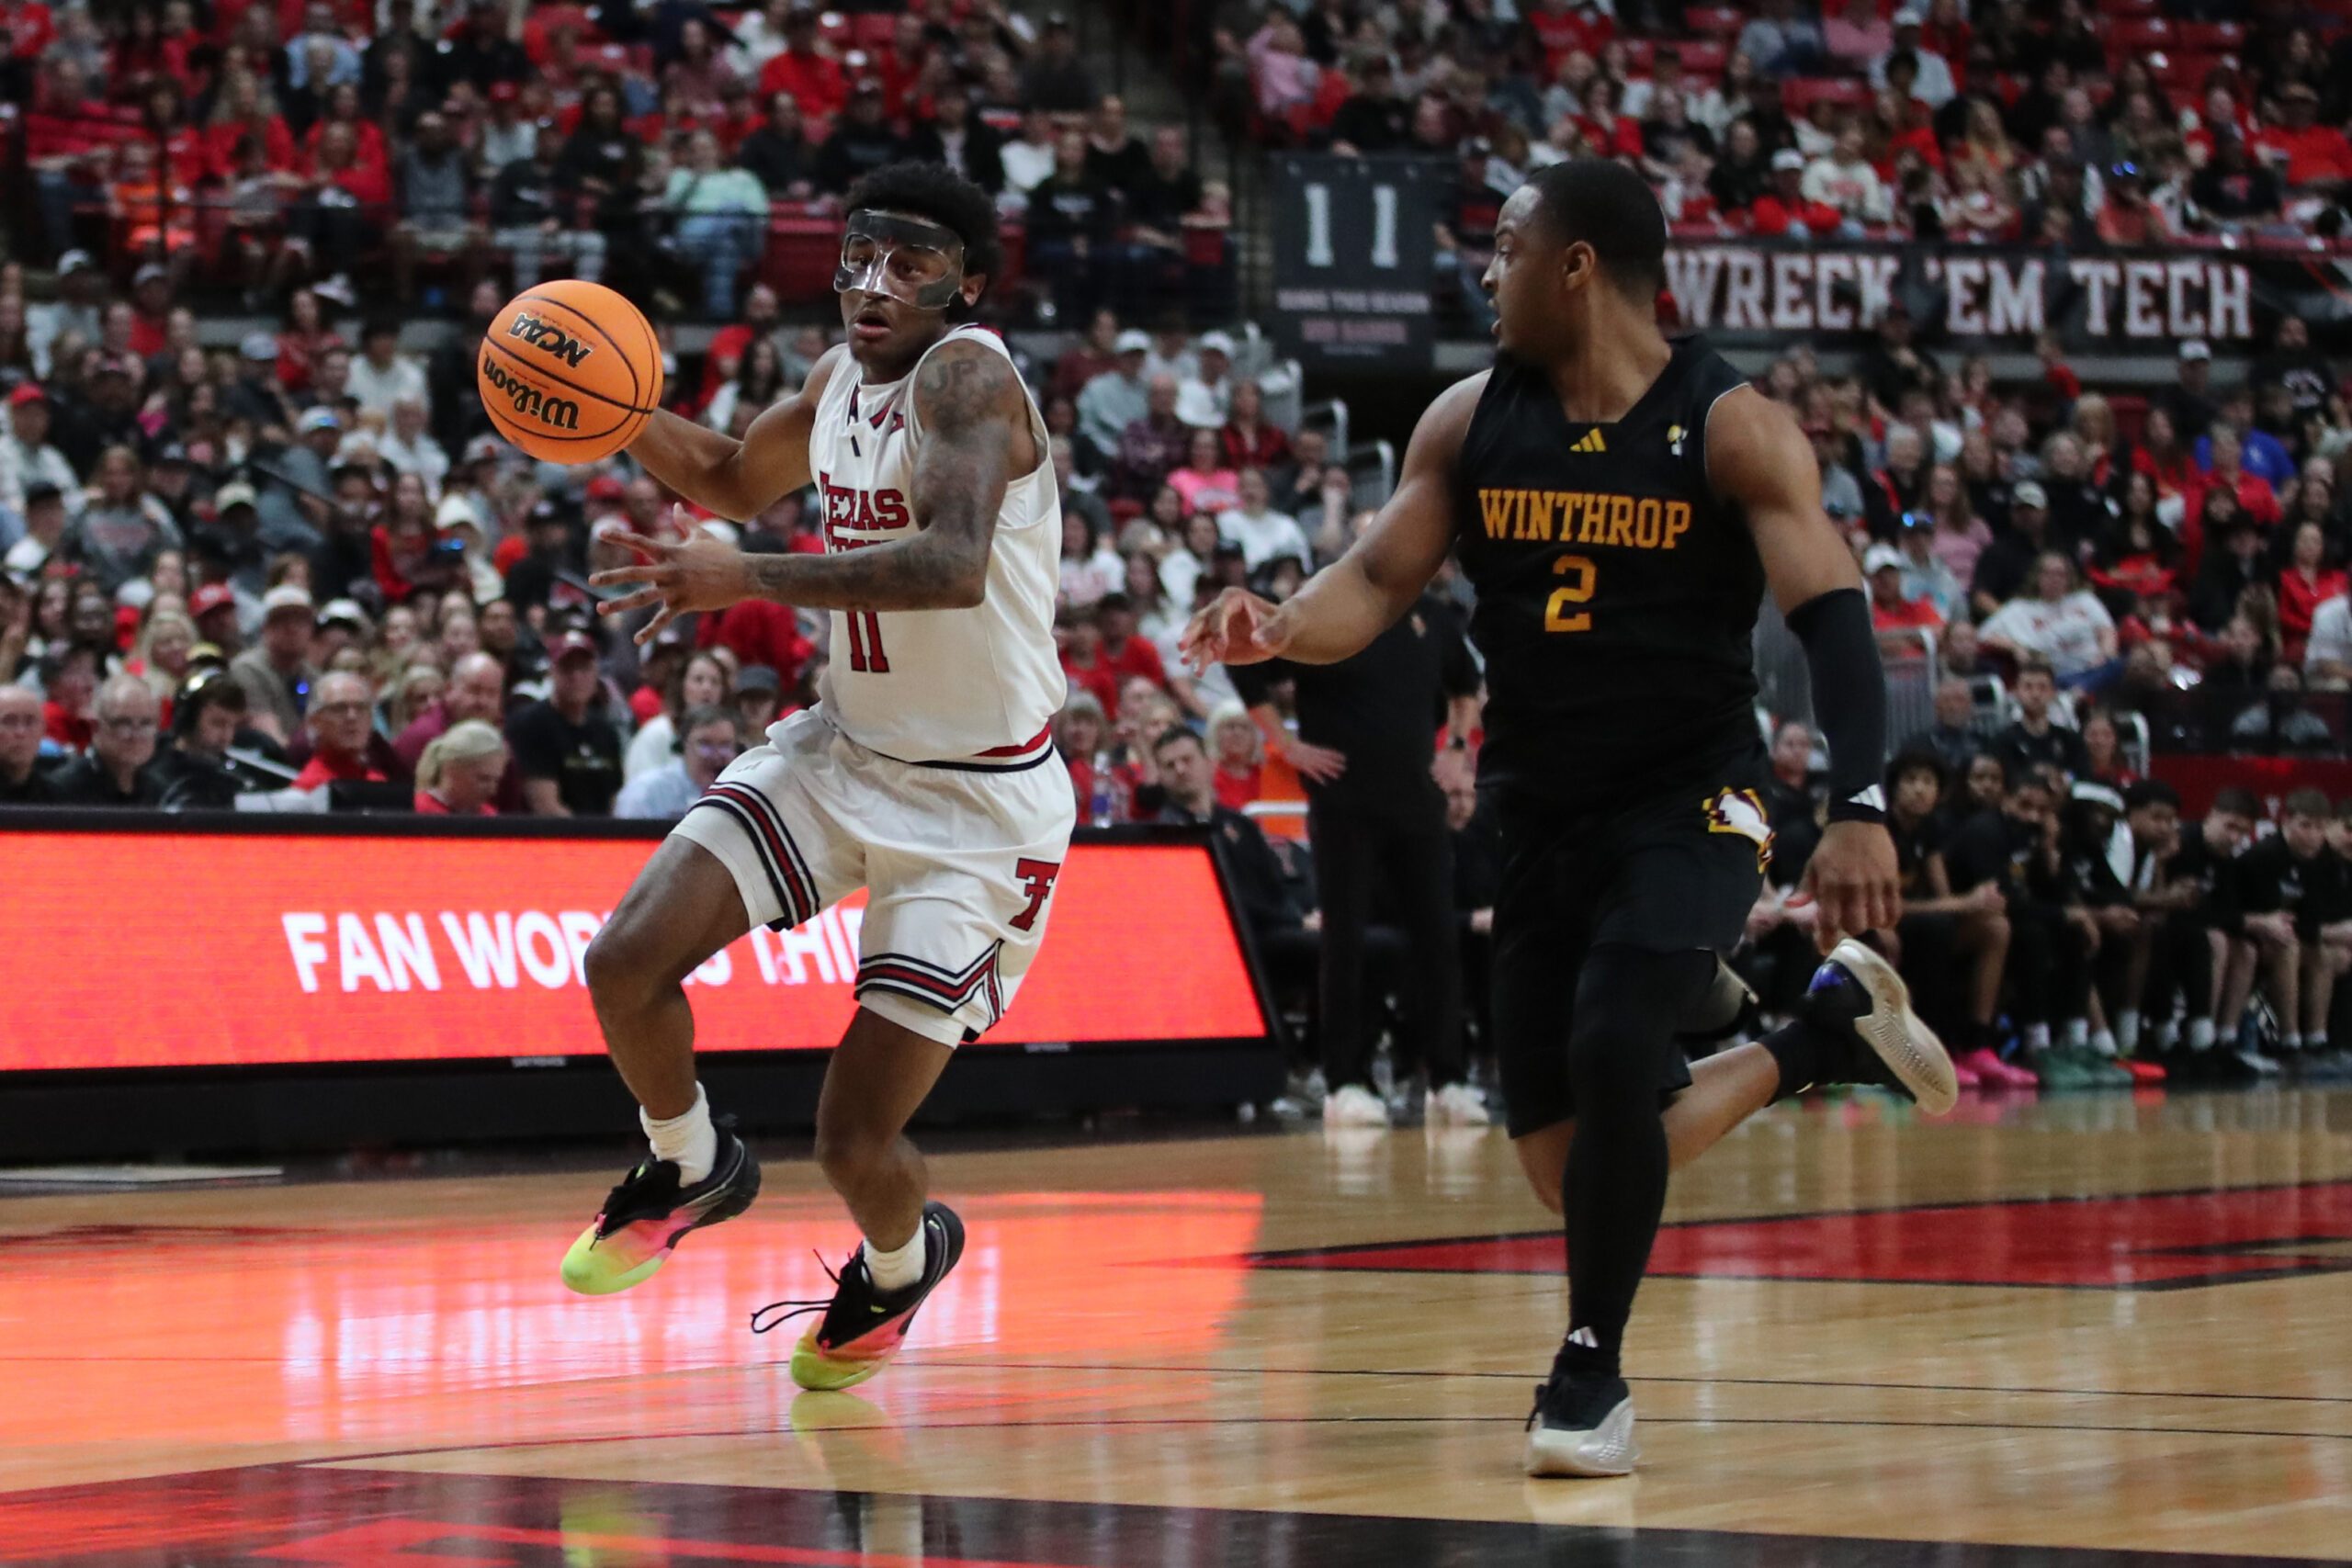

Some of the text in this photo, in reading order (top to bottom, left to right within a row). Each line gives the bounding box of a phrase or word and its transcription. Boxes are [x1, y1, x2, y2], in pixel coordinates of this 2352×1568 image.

[1304, 184, 1399, 267] 11
[1663, 249, 2253, 338] WRECK 'EM TECH
[508, 311, 594, 369] NCAA
[483, 349, 580, 431] Wilson
[1477, 488, 1691, 550] WINTHROP
[1544, 554, 1597, 633] 2
[280, 910, 442, 993] FAN
